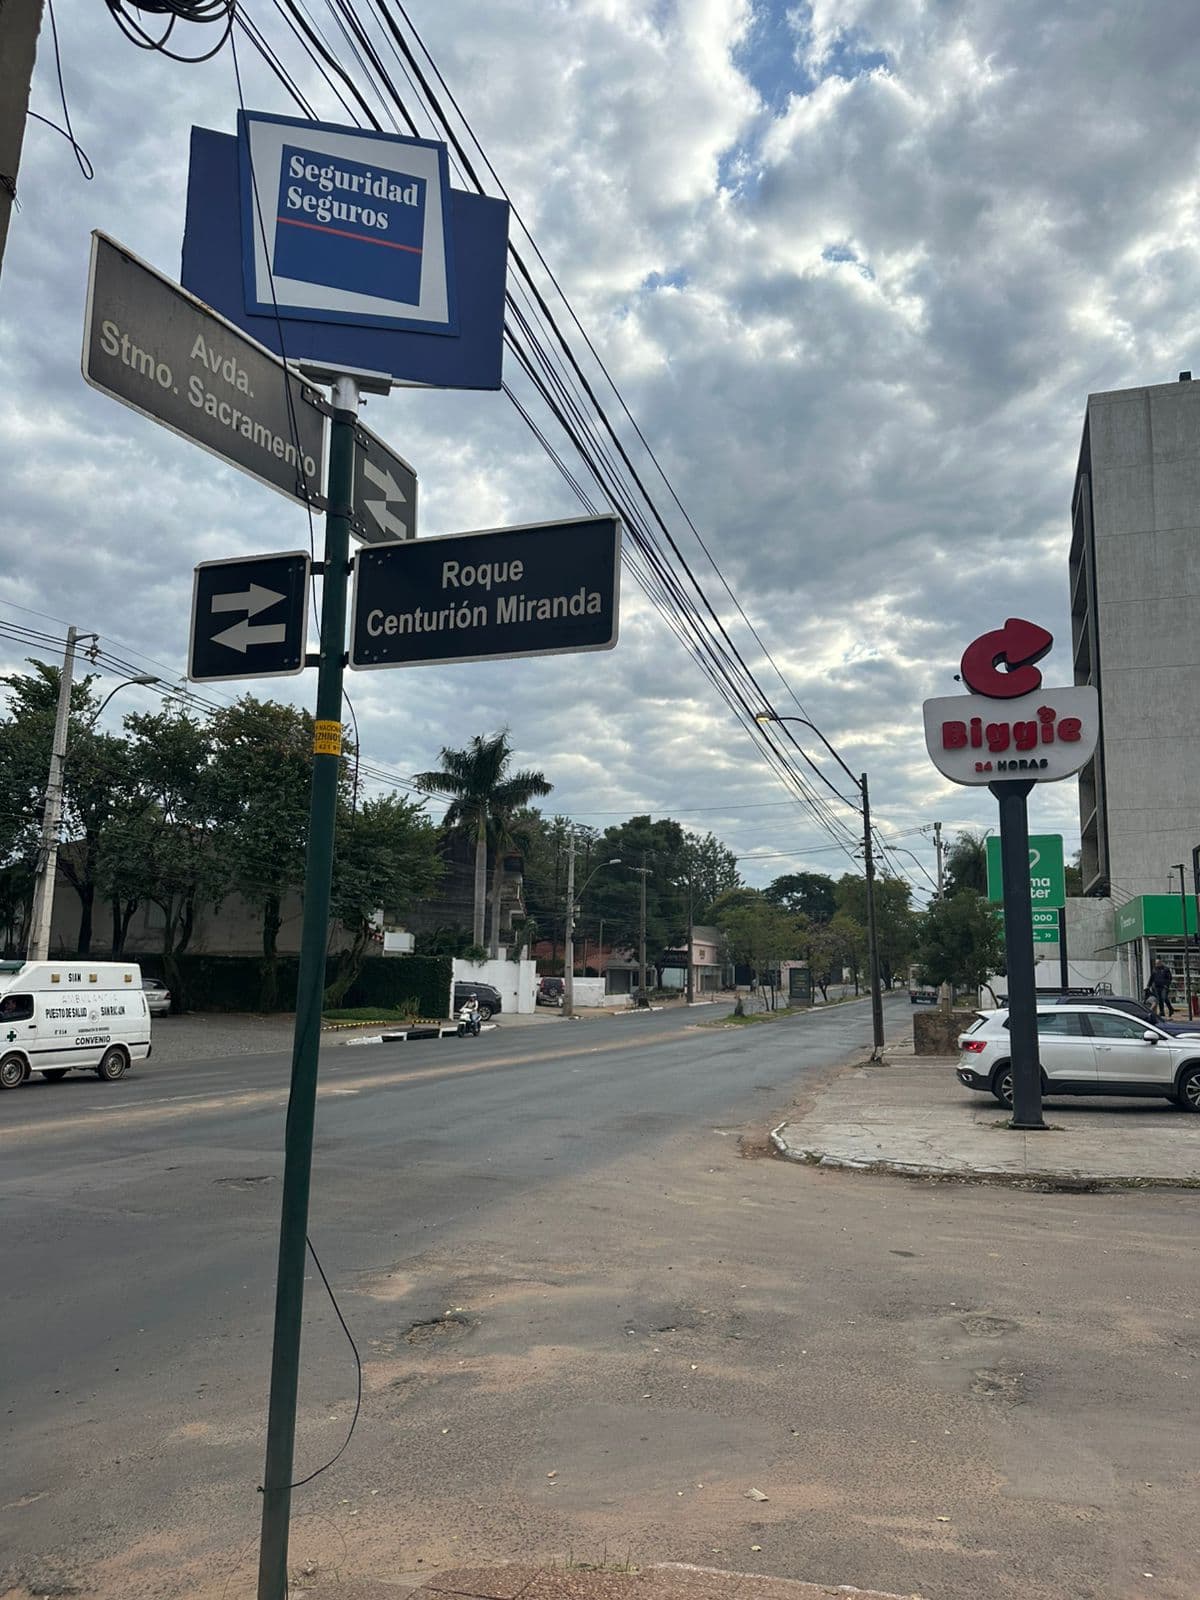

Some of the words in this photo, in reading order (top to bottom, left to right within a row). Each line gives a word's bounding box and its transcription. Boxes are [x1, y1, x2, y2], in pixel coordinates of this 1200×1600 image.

[289, 155, 418, 207] Seguridad
[287, 186, 388, 230] Seguros
[190, 334, 254, 398] Avda.
[101, 320, 178, 395] Stmo.
[187, 375, 316, 478] Sacramento
[442, 560, 524, 590] Roque
[366, 601, 488, 637] Centurión
[496, 586, 601, 625] Miranda
[942, 706, 1082, 752] Biggie
[975, 761, 992, 772] 24
[997, 759, 1048, 771] HORAS
[1030, 878, 1050, 887] ma
[1030, 887, 1051, 898] ter
[45, 1008, 65, 1018] PUESTO
[75, 1035, 111, 1046] CONVENIO
